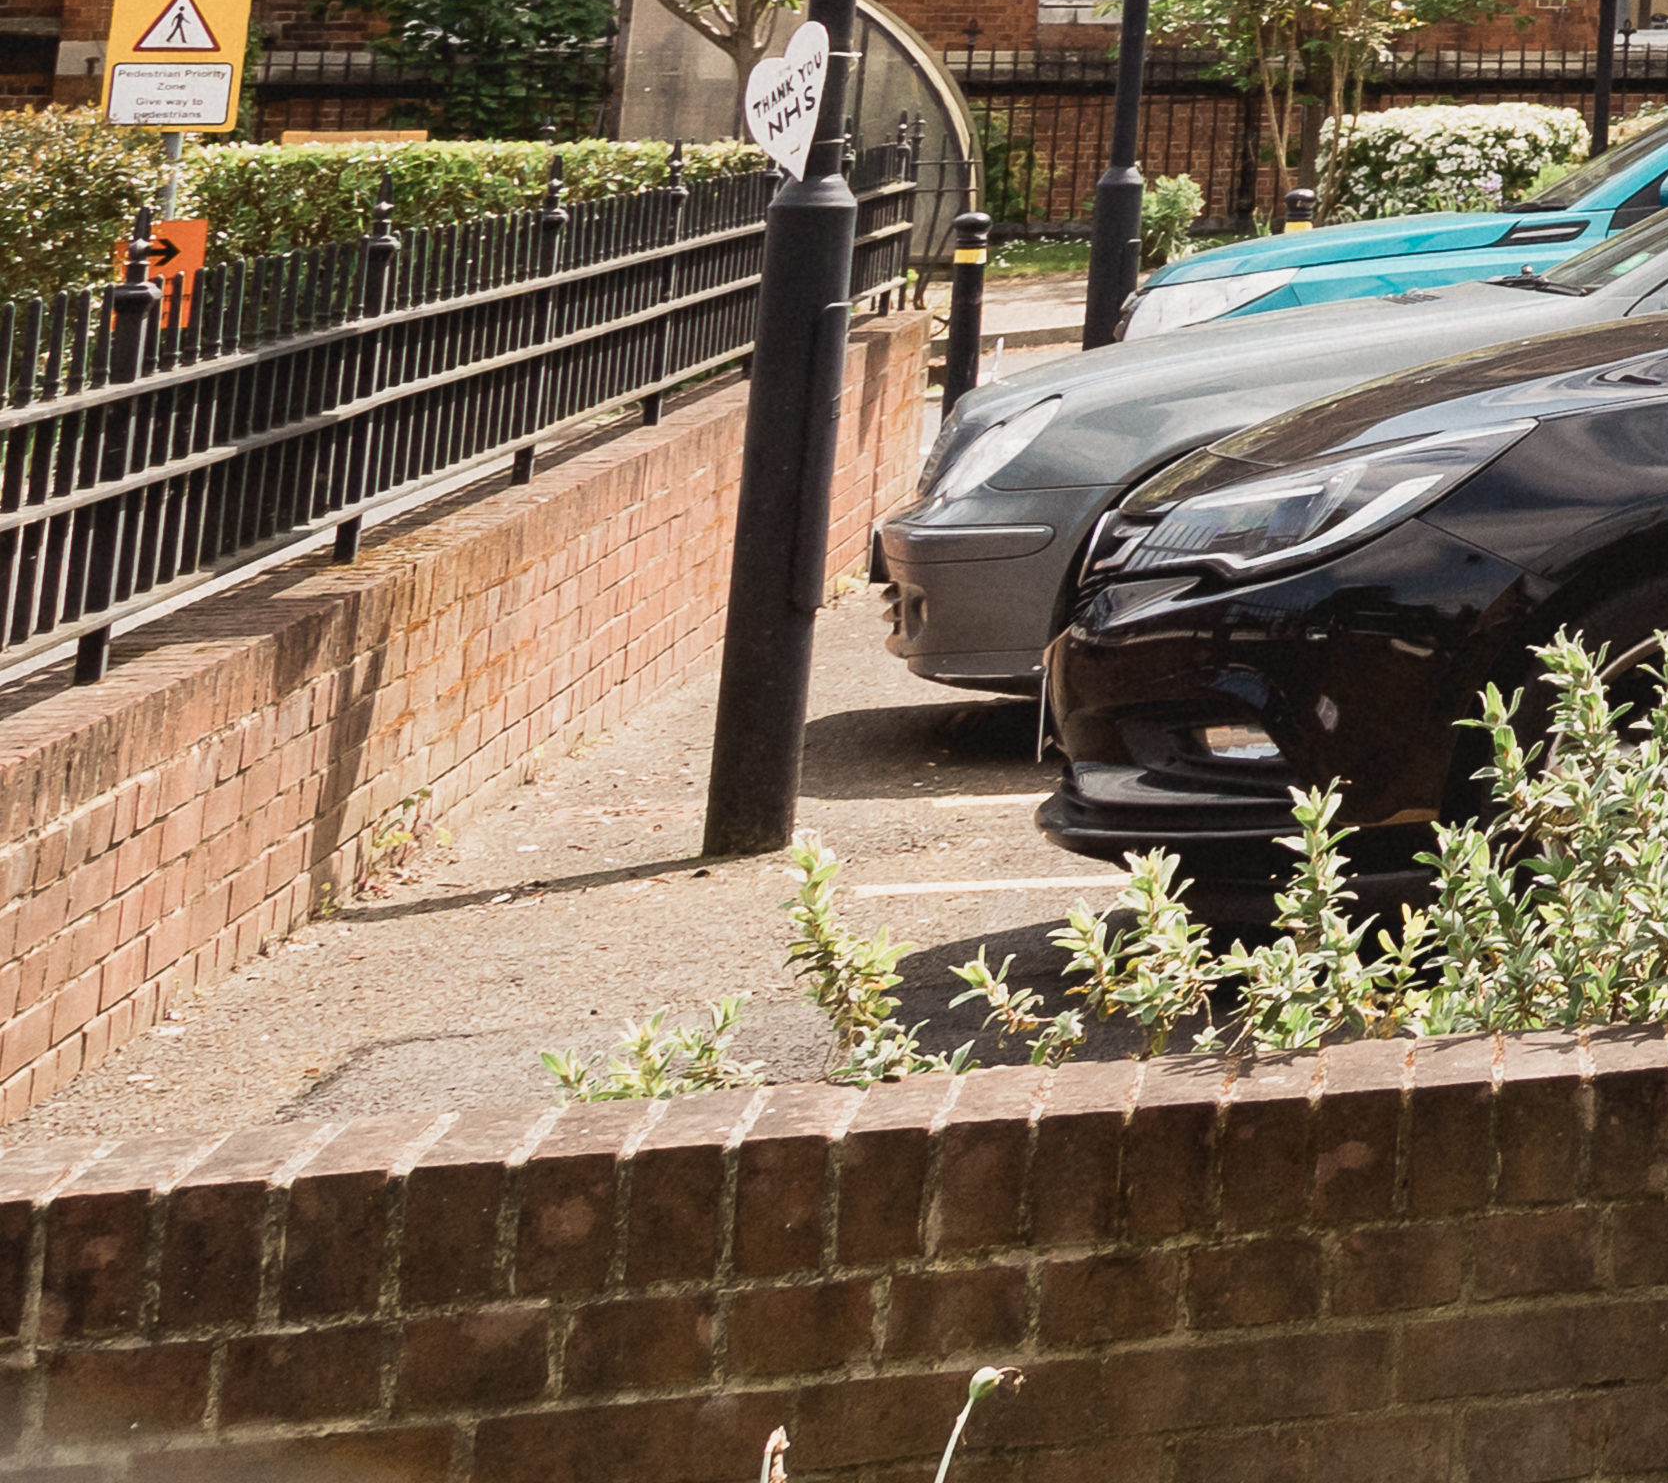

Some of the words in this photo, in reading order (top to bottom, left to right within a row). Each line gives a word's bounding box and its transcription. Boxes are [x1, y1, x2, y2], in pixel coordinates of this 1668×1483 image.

[117, 69, 181, 78] Pedestrian
[184, 69, 227, 80] Priority
[156, 82, 187, 91] Zone
[752, 74, 795, 118] THANK
[797, 51, 823, 83] YOU
[135, 97, 161, 106] Give
[165, 98, 188, 107] way
[192, 97, 204, 106] to
[133, 110, 203, 120] pedestrians
[767, 85, 816, 141] NHS
